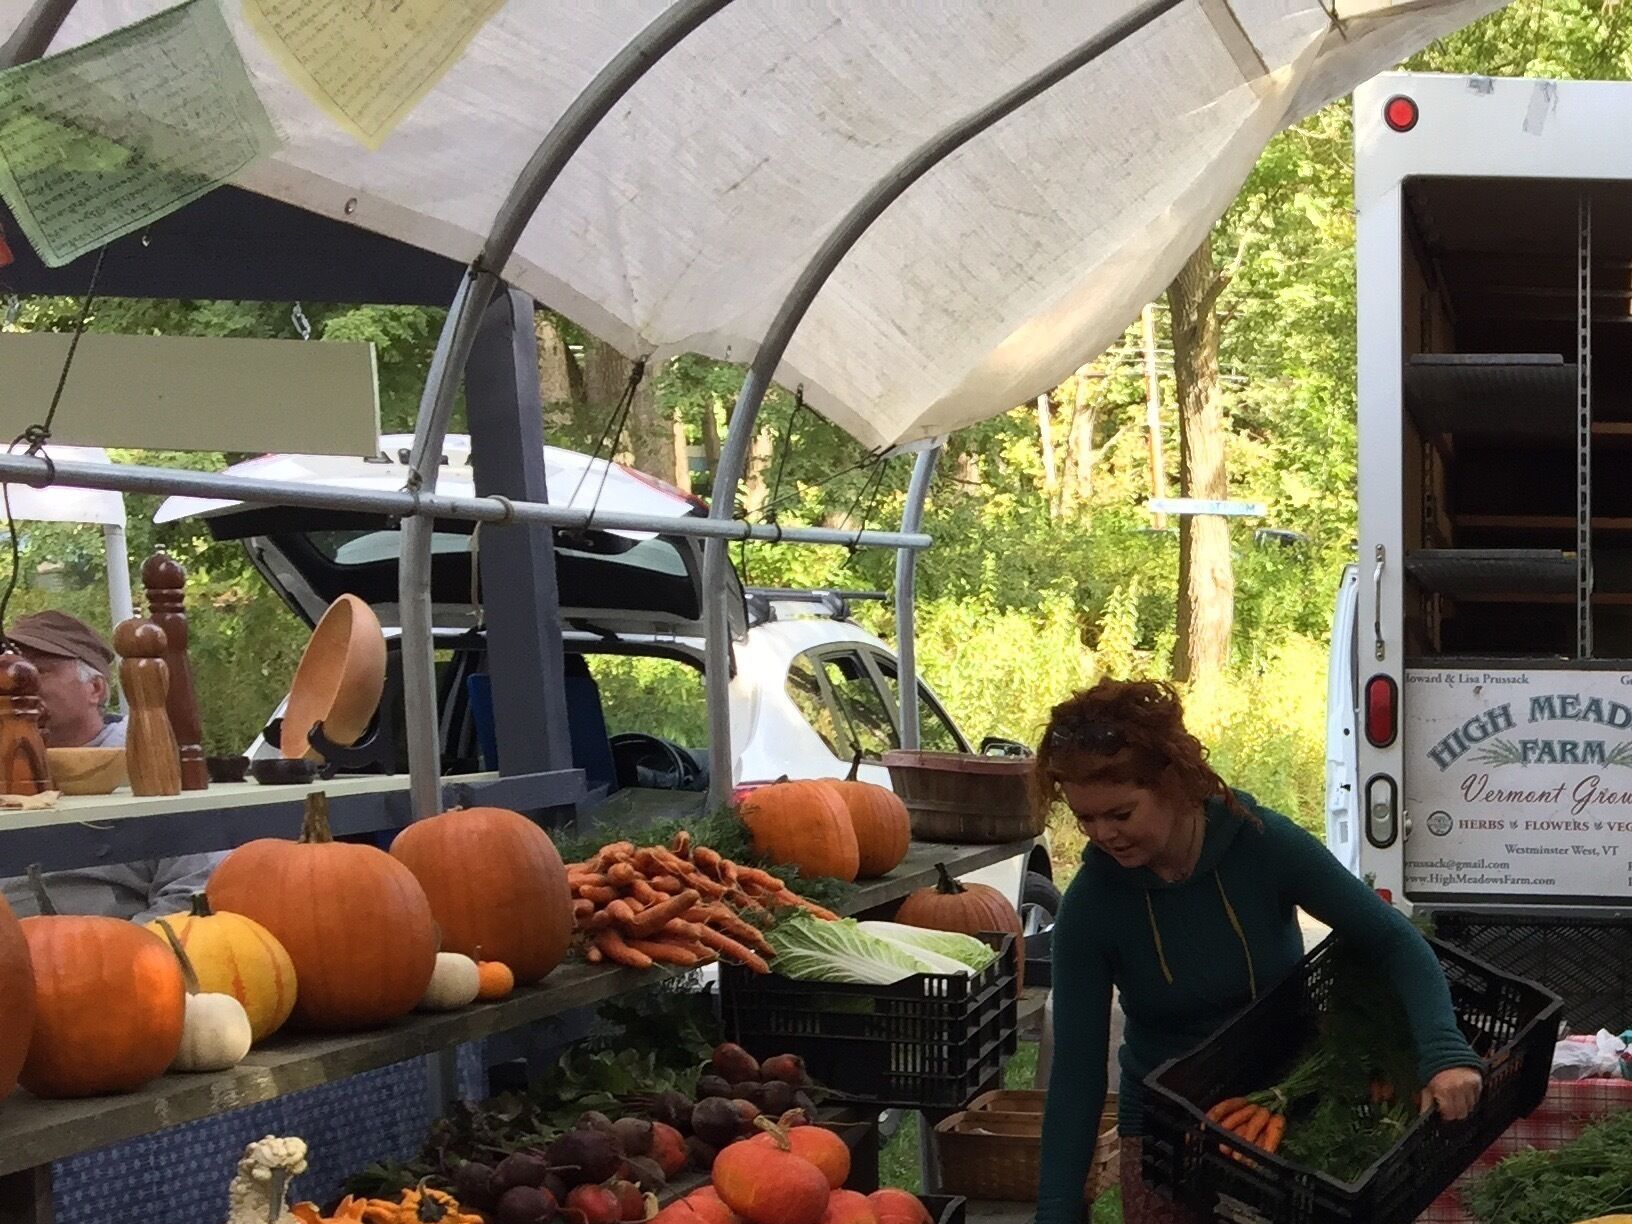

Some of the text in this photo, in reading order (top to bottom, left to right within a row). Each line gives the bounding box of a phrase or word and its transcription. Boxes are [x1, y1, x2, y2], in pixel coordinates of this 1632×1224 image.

[1193, 502, 1256, 513] STROOM
[1445, 673, 1456, 684] &
[1459, 673, 1480, 684] Lisa
[1483, 673, 1530, 684] Prussack
[1426, 702, 1516, 772] HIGH
[1519, 739, 1606, 765] FARM
[1461, 773, 1565, 805] Vermont
[1459, 819, 1504, 831] HERBS
[1524, 820, 1590, 833] FLOWERS
[1504, 844, 1619, 858] Westminster West, VT
